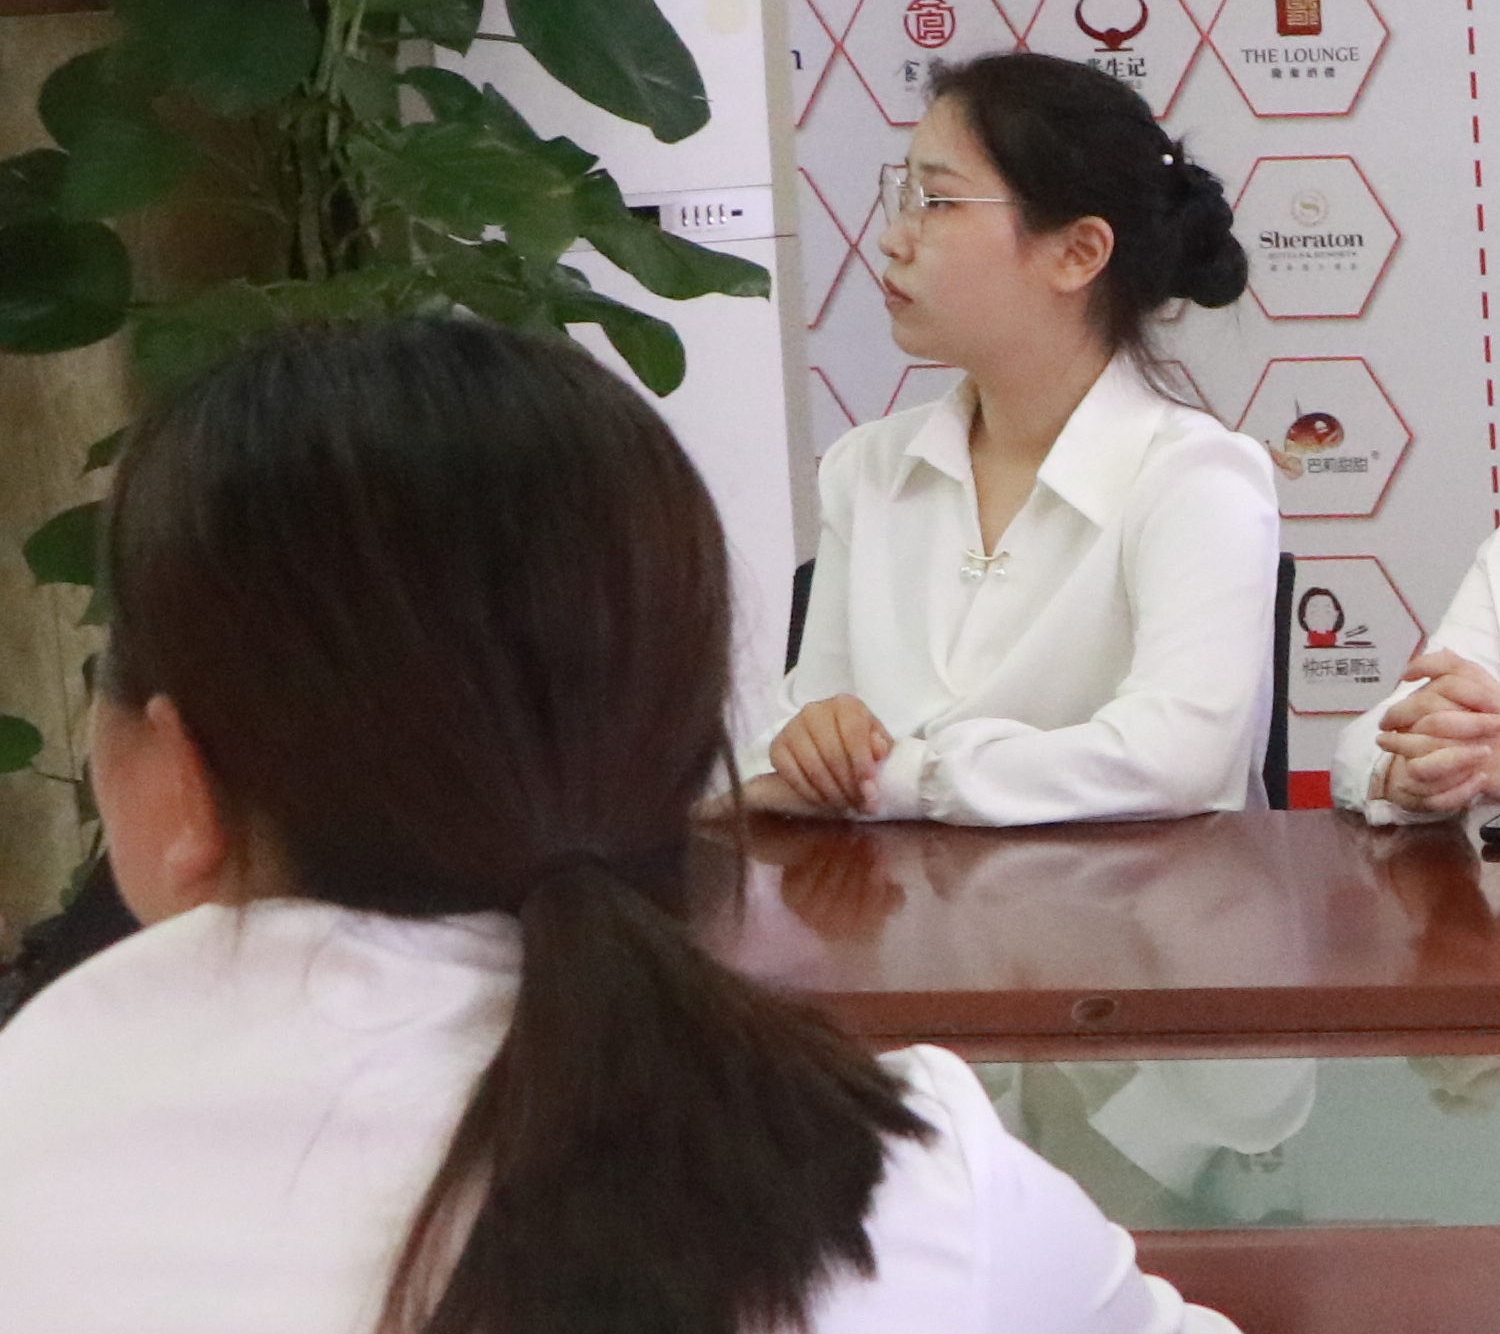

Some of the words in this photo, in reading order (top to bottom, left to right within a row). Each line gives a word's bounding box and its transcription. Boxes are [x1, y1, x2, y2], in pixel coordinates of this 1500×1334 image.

[1242, 49, 1277, 63] THE
[1285, 47, 1358, 62] LOUNGE
[1260, 232, 1363, 248] Sheraton
